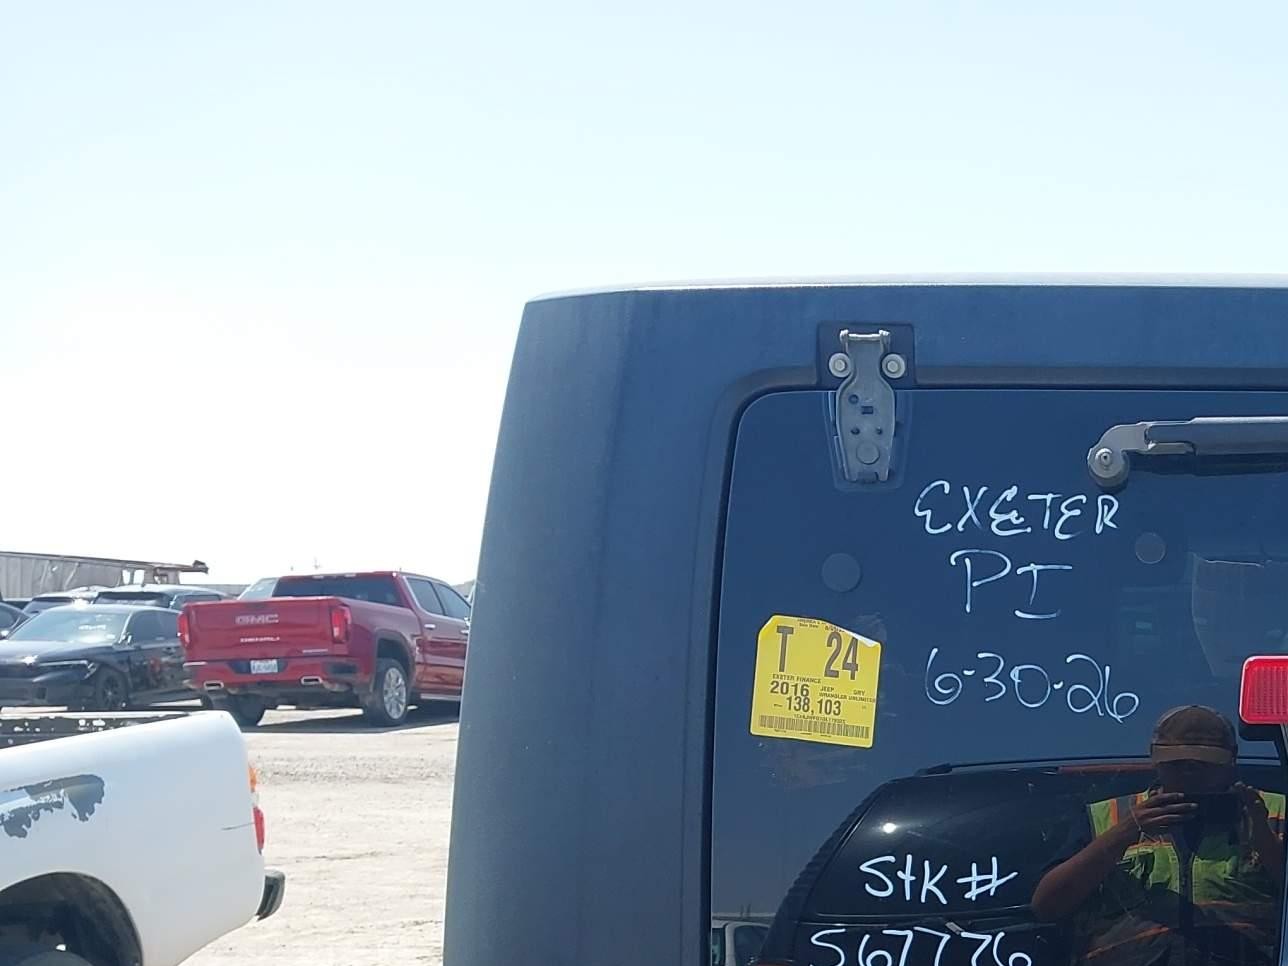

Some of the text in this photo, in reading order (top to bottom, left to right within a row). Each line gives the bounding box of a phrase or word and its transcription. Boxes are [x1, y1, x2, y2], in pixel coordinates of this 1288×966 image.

[914, 478, 1119, 541] EXETER
[950, 549, 1073, 620] PI
[776, 625, 859, 681] T 24
[769, 680, 810, 697] 2016
[786, 695, 842, 716] 138,103
[926, 647, 1140, 724] 6-30-26
